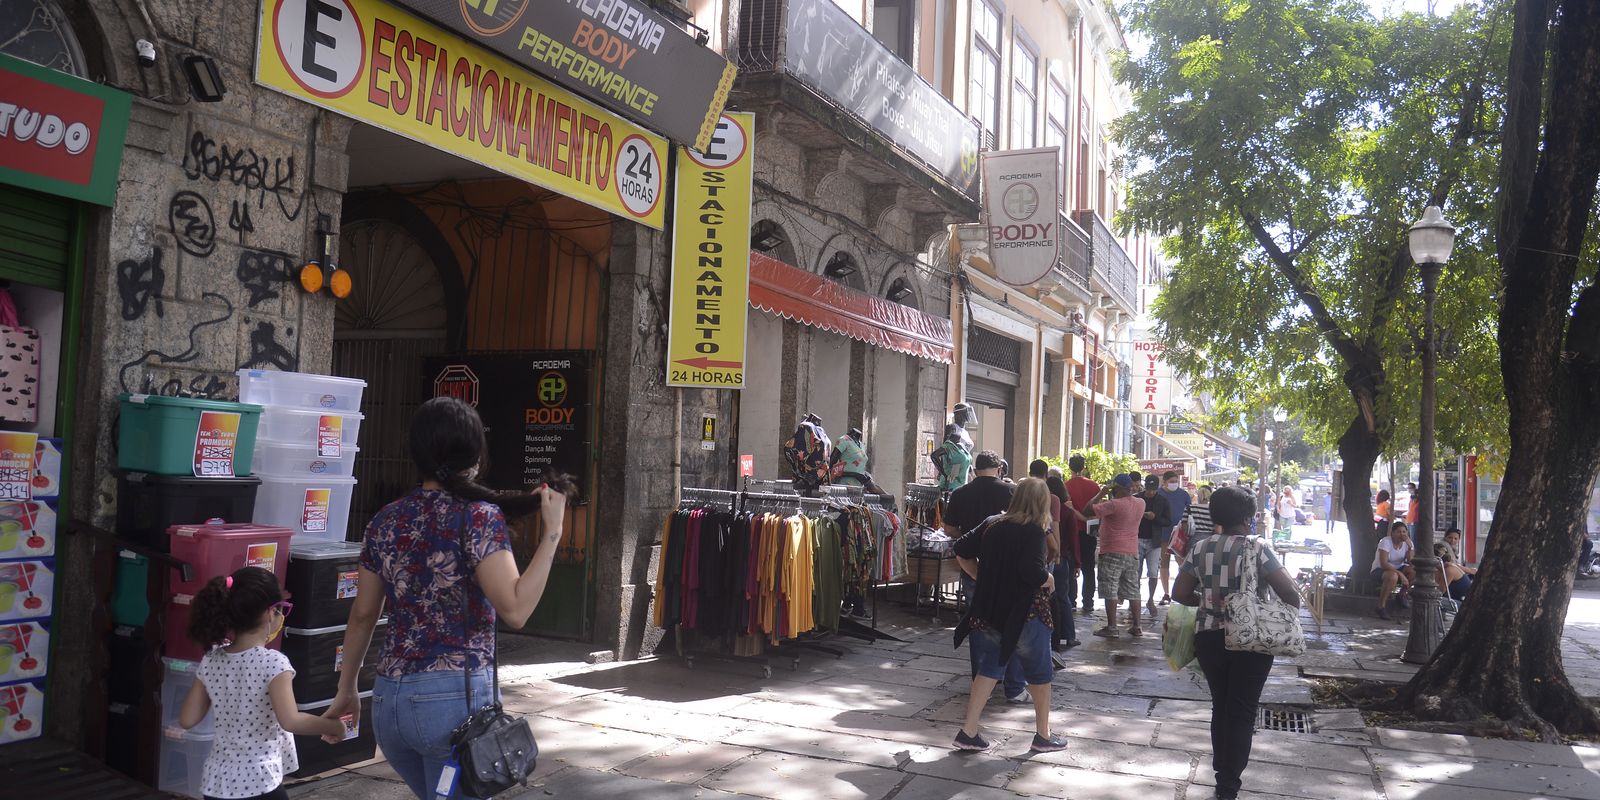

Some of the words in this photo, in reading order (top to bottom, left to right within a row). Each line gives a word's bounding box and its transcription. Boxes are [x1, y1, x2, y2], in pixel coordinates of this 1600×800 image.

[566, 0, 666, 55] CADEMIA
[301, 0, 343, 83] E
[572, 18, 637, 71] BODY
[518, 26, 659, 117] PERFORMANCE
[876, 61, 906, 100] Pilates
[912, 88, 932, 124] Muay
[368, 17, 613, 192] ESTACIONAMENTO
[882, 96, 905, 129] Boxe
[625, 143, 653, 184] 24
[999, 172, 1042, 181] ACADEMIA
[621, 180, 653, 205] HORAS
[991, 222, 1053, 241] BODY
[994, 239, 1054, 249] ERFORMANCE
[533, 360, 571, 370] ACADEMIA
[671, 370, 688, 382] 24
[692, 371, 743, 384] HORAS
[1144, 354, 1158, 410] VITORIA
[525, 408, 575, 424] BODY
[526, 423, 575, 431] PERFORMANCE
[525, 434, 562, 443] Musculação
[525, 445, 544, 453] Dança
[525, 456, 552, 465] Spinning
[1152, 462, 1173, 470] Pedro
